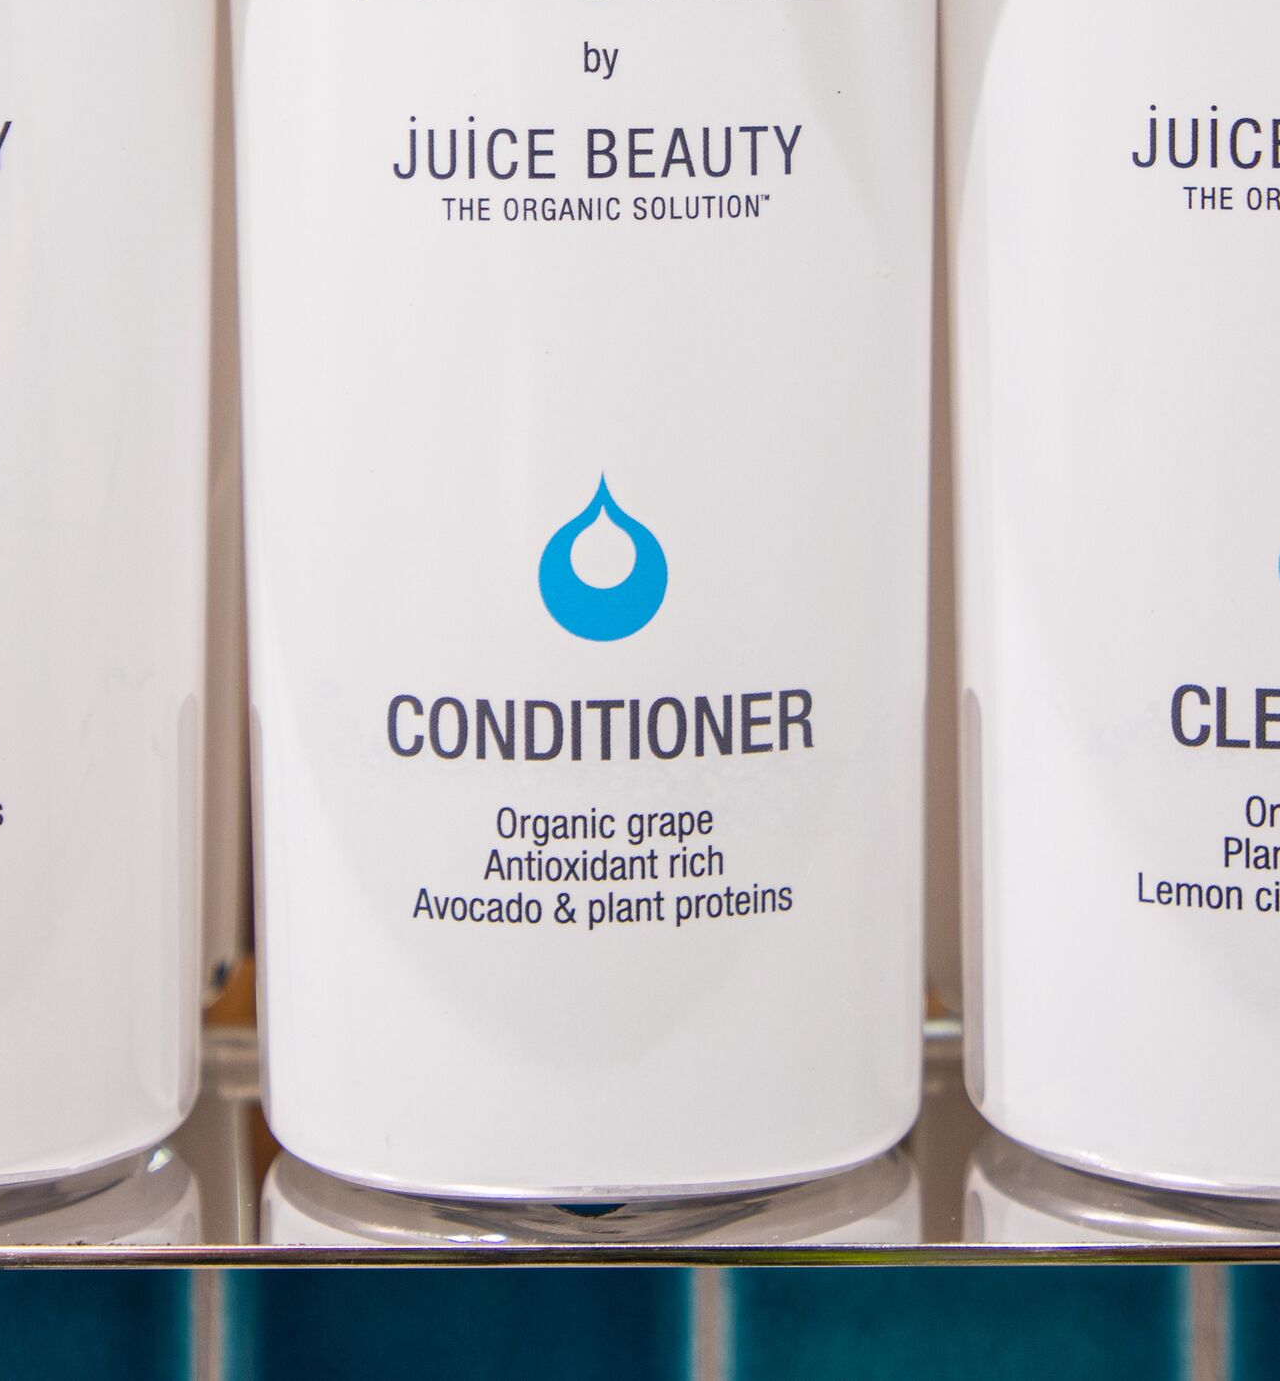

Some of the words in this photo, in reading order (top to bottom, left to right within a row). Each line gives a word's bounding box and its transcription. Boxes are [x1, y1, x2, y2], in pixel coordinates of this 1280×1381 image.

[583, 40, 619, 80] by
[586, 124, 803, 179] BEAUTY
[441, 197, 491, 221] THE
[503, 196, 621, 222] ORGANIC
[1182, 186, 1234, 211] THE
[387, 688, 815, 762] CONDITIONER
[496, 806, 616, 848] Organic
[627, 809, 714, 847] grape
[483, 848, 659, 883] Antioxidant
[669, 844, 724, 879] rich
[412, 887, 543, 925] Avocado
[553, 892, 577, 925] &
[588, 890, 665, 931] plant
[675, 882, 793, 928] proteins
[1138, 871, 1243, 911] Lemon
